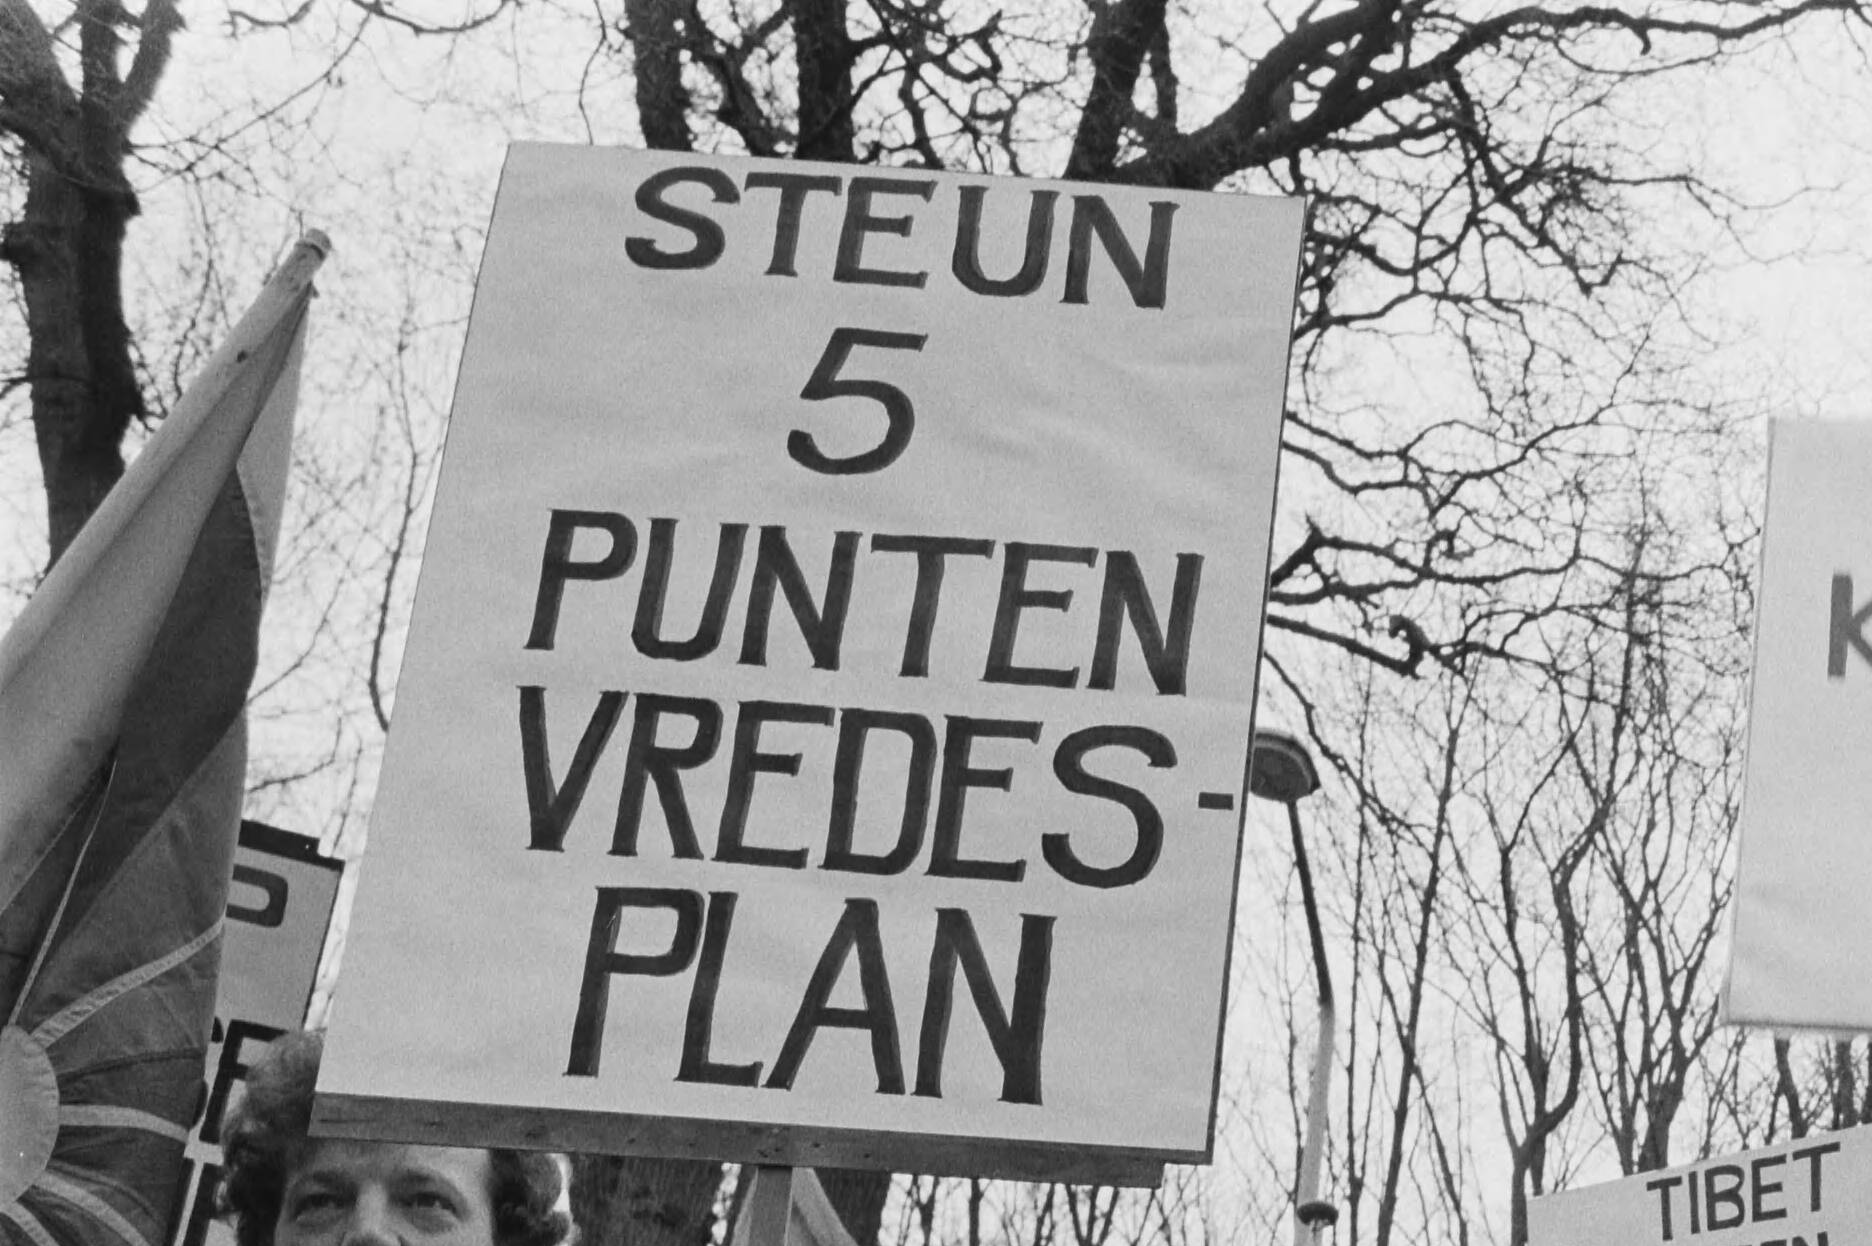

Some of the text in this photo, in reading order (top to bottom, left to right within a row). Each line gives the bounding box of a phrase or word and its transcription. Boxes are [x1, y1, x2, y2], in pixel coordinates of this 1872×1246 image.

[624, 166, 1180, 310] STEUN
[786, 327, 928, 475] 5
[522, 507, 1204, 696] PUNTEN
[515, 684, 1234, 888] VREDES-
[562, 884, 1057, 1105] PLAN
[1645, 1140, 1841, 1242] TIBET
